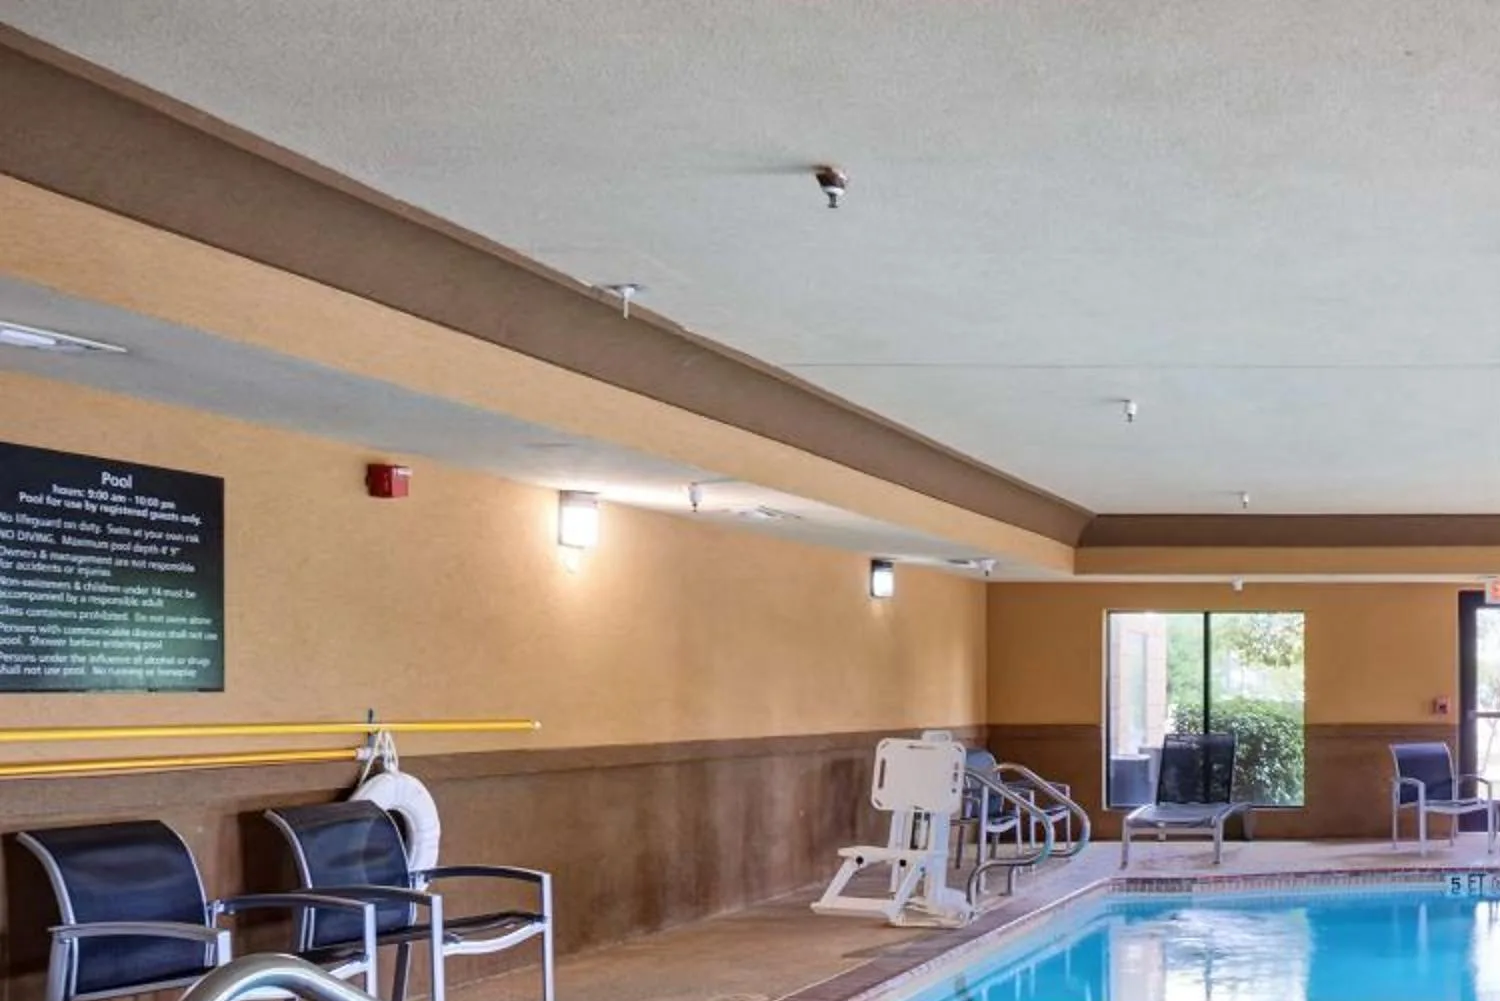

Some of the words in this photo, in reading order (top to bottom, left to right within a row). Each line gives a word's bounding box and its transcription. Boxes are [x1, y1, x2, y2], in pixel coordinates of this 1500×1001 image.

[102, 471, 132, 488] Pool
[19, 491, 43, 504] Pool
[46, 495, 61, 506] for
[64, 500, 82, 508] use
[84, 499, 97, 512] by
[99, 504, 148, 517] registered
[149, 511, 179, 521] guests
[16, 513, 61, 529] lifeguard
[64, 521, 76, 529] on
[143, 530, 163, 540] your
[110, 541, 131, 552] pool
[133, 542, 158, 554] depth
[15, 562, 61, 573] accidents
[39, 549, 47, 559] &
[49, 551, 112, 565] management
[148, 561, 196, 573] responsible
[73, 580, 81, 591] &
[83, 581, 121, 593] children
[66, 591, 78, 604] by
[1451, 877, 1461, 894] 5
